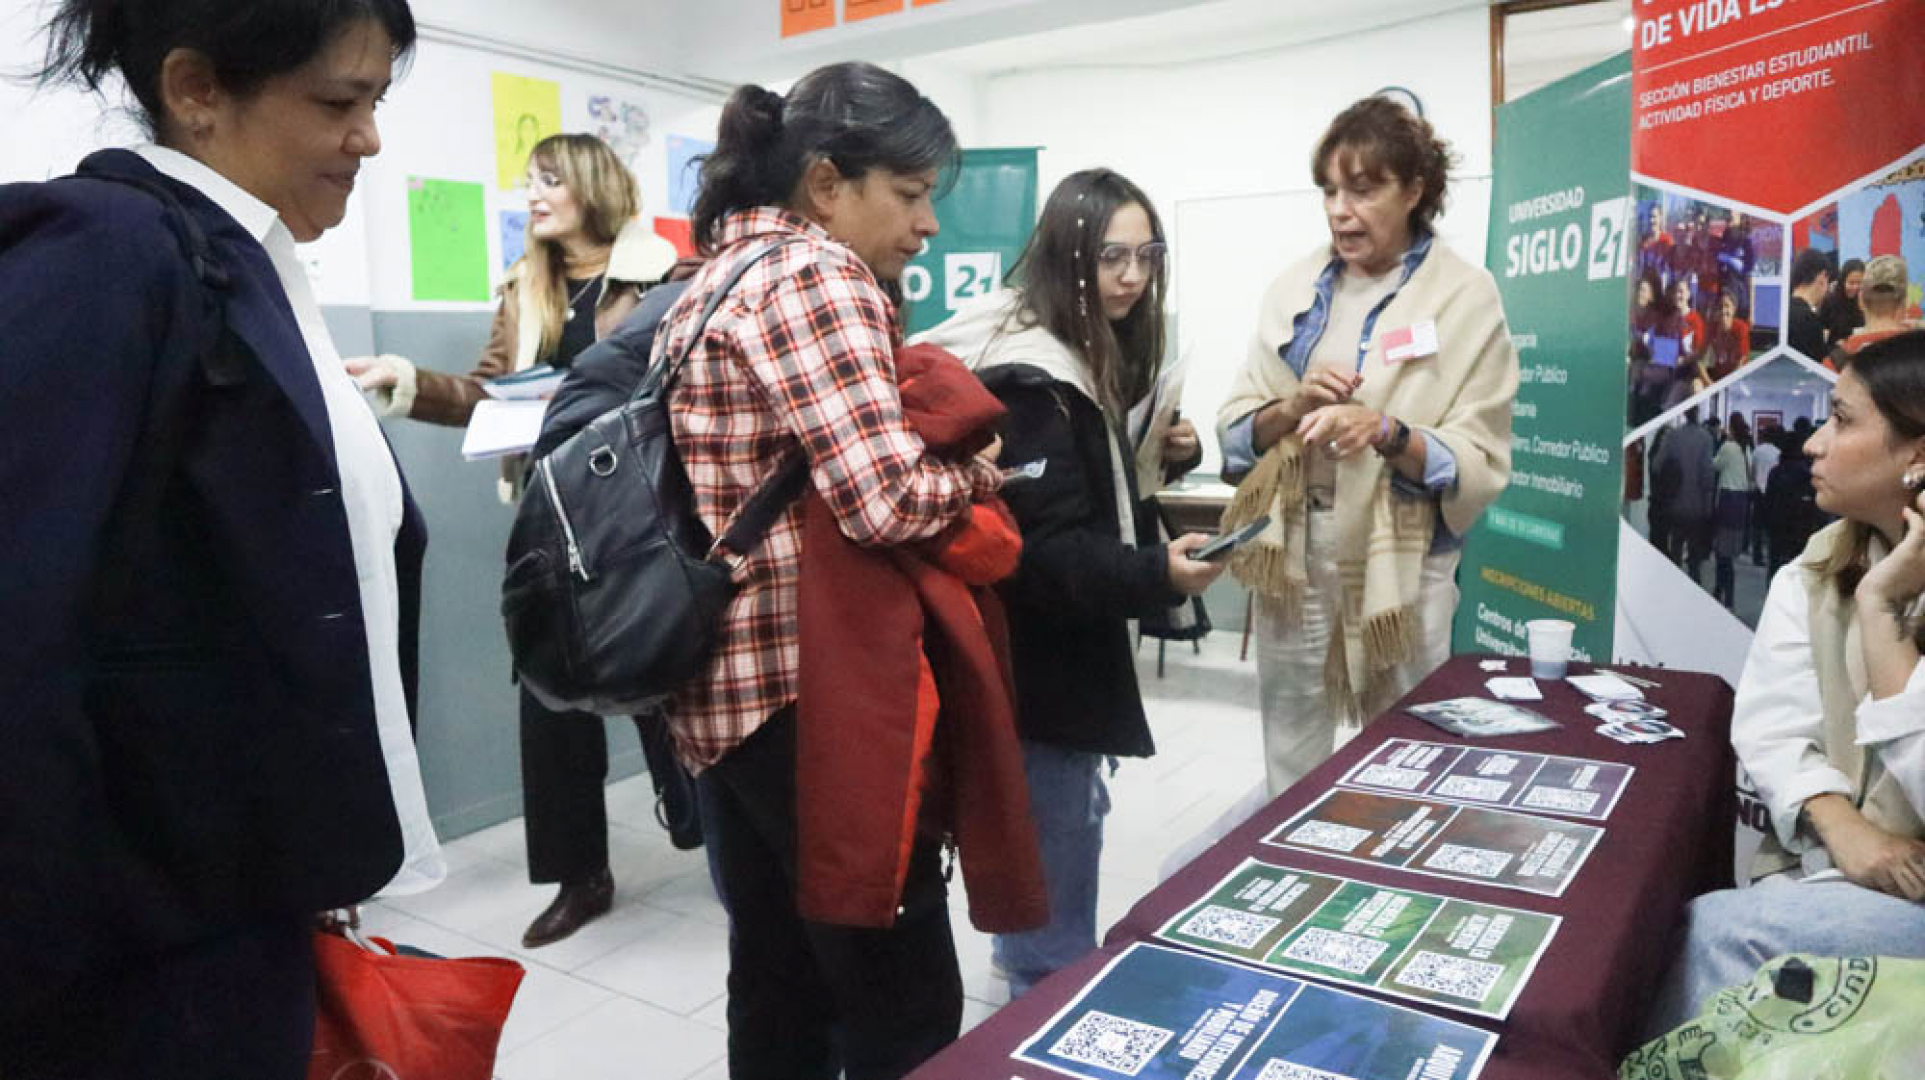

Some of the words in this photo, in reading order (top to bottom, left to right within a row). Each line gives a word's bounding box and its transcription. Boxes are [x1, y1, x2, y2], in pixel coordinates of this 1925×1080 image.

[1641, 12, 1672, 51] DE
[1678, 0, 1741, 37] VIDA
[1638, 81, 1690, 109] SECCIÓN
[1693, 61, 1765, 95] BIENESTAR
[1768, 31, 1873, 75] ESTUDIANTIL
[1638, 102, 1703, 131] ACTIVIDAD
[1704, 90, 1746, 114] FÍSICA
[1750, 88, 1759, 104] Y
[1762, 68, 1836, 101] DEPORTE.
[1508, 186, 1584, 224] UNIVERSIDAD
[1506, 222, 1583, 278] SIGLO
[1591, 212, 1626, 279] 21
[1478, 602, 1512, 633] Centros
